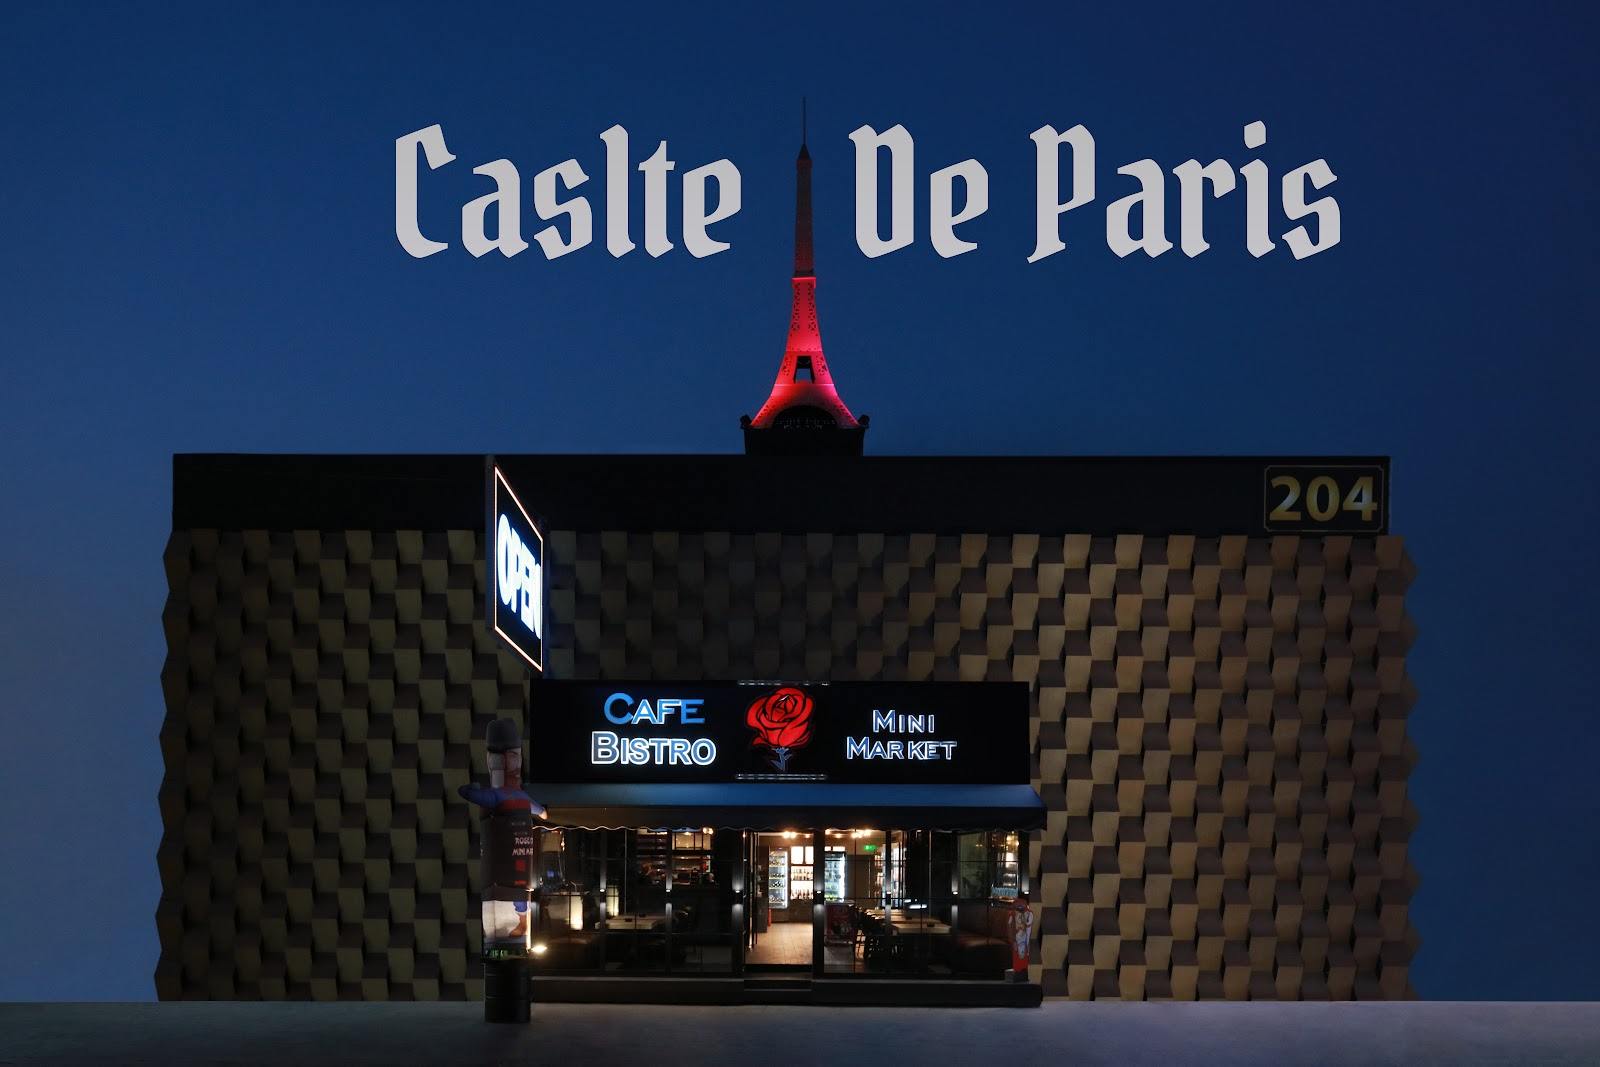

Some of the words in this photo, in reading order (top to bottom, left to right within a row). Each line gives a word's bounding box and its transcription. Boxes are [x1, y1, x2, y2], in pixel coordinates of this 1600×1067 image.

[1269, 475, 1378, 522] 204
[497, 513, 541, 640] OPEN
[603, 692, 706, 725] CAFE
[872, 709, 936, 734] MINI
[590, 730, 717, 766] BISTRO
